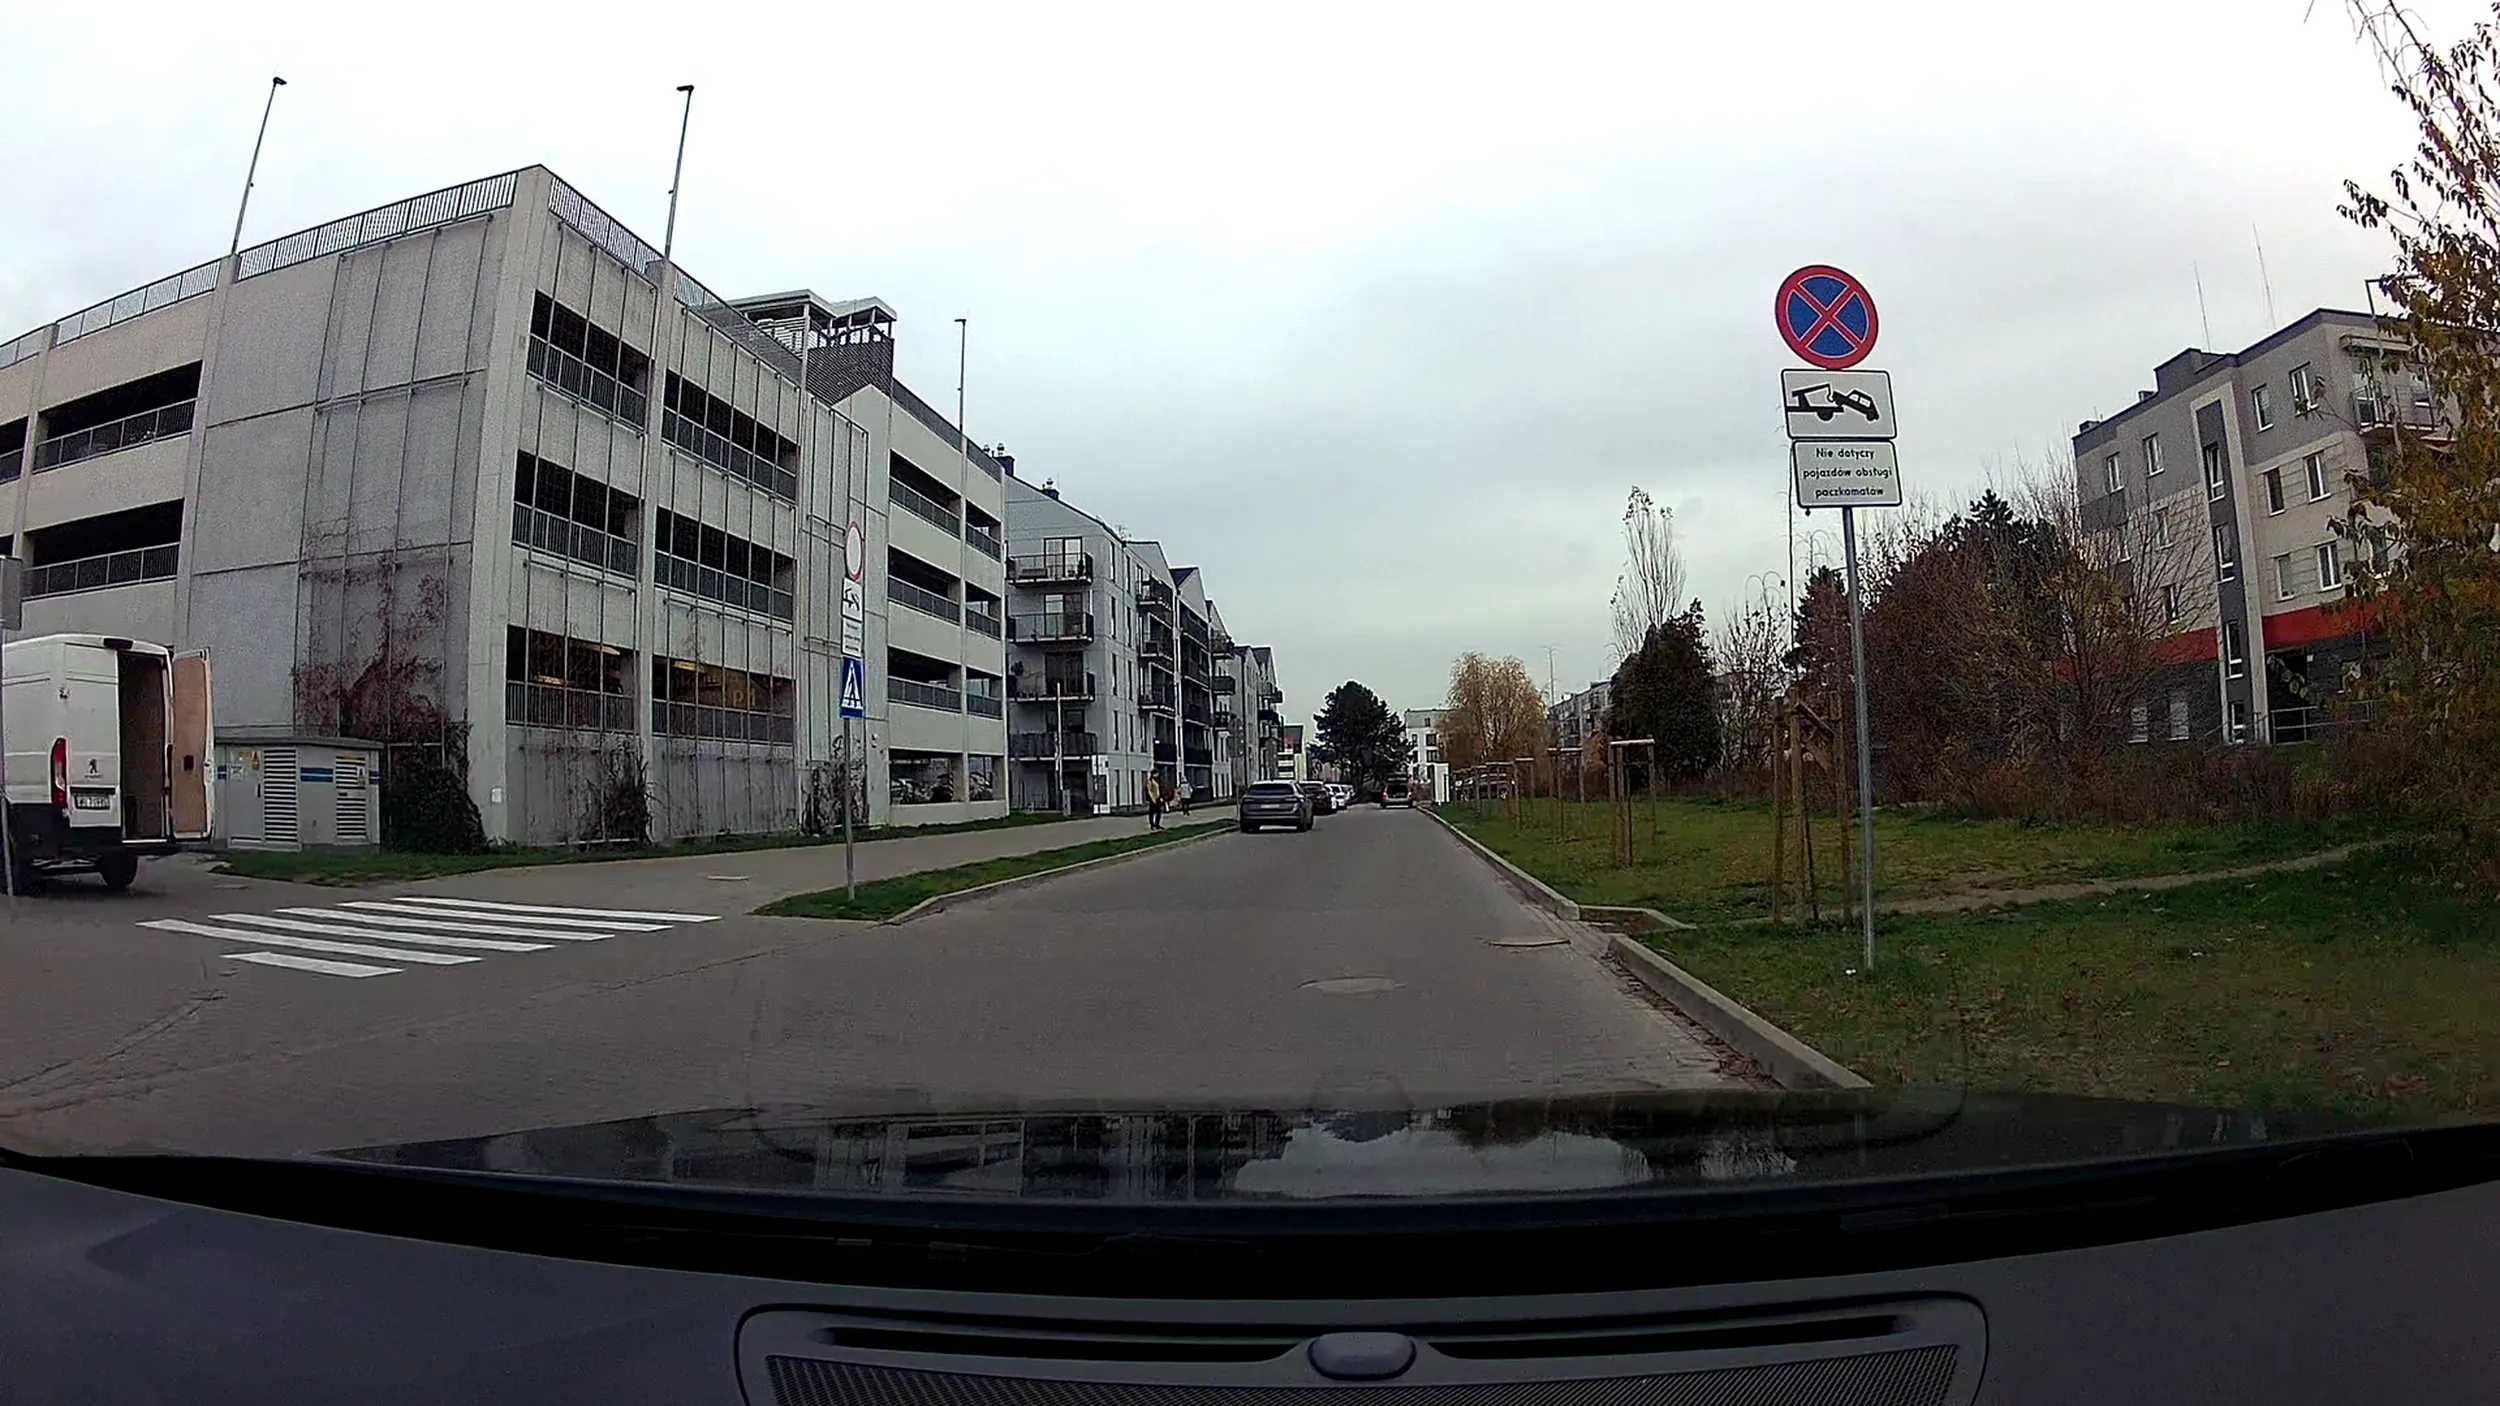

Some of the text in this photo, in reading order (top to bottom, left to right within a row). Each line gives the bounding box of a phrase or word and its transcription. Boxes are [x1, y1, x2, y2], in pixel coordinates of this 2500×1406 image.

[1816, 447, 1875, 460] Nie dotyczy
[1803, 466, 1893, 480] pojazdów obsługi
[1815, 485, 1884, 500] paczkomatów
